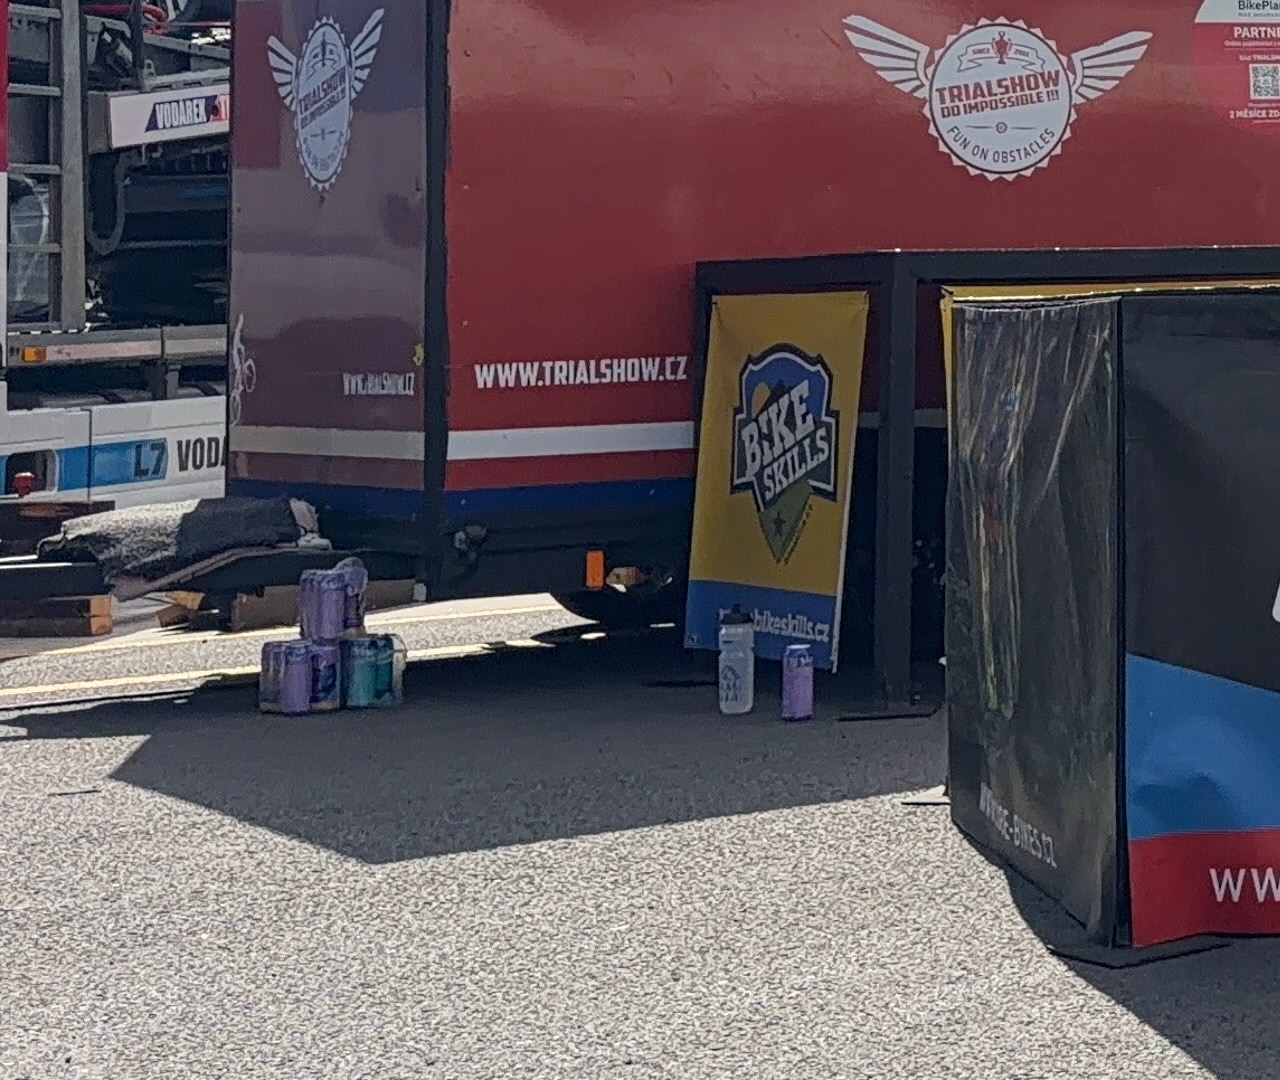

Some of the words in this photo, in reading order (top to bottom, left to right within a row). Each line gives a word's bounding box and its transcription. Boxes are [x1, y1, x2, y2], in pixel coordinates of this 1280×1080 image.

[935, 70, 1060, 105] TRIALSHOW
[941, 104, 961, 118] DO
[963, 91, 1044, 115] IMPOSSIBLE
[947, 125, 971, 150] FUN
[971, 144, 990, 161] ON
[993, 127, 1055, 163] OBSTACLES
[474, 356, 688, 389] WWW.TRIALSHOW.CZ
[741, 379, 815, 479] BIKE
[762, 426, 829, 502] SKILLS
[719, 608, 830, 642] bikeskills.cz
